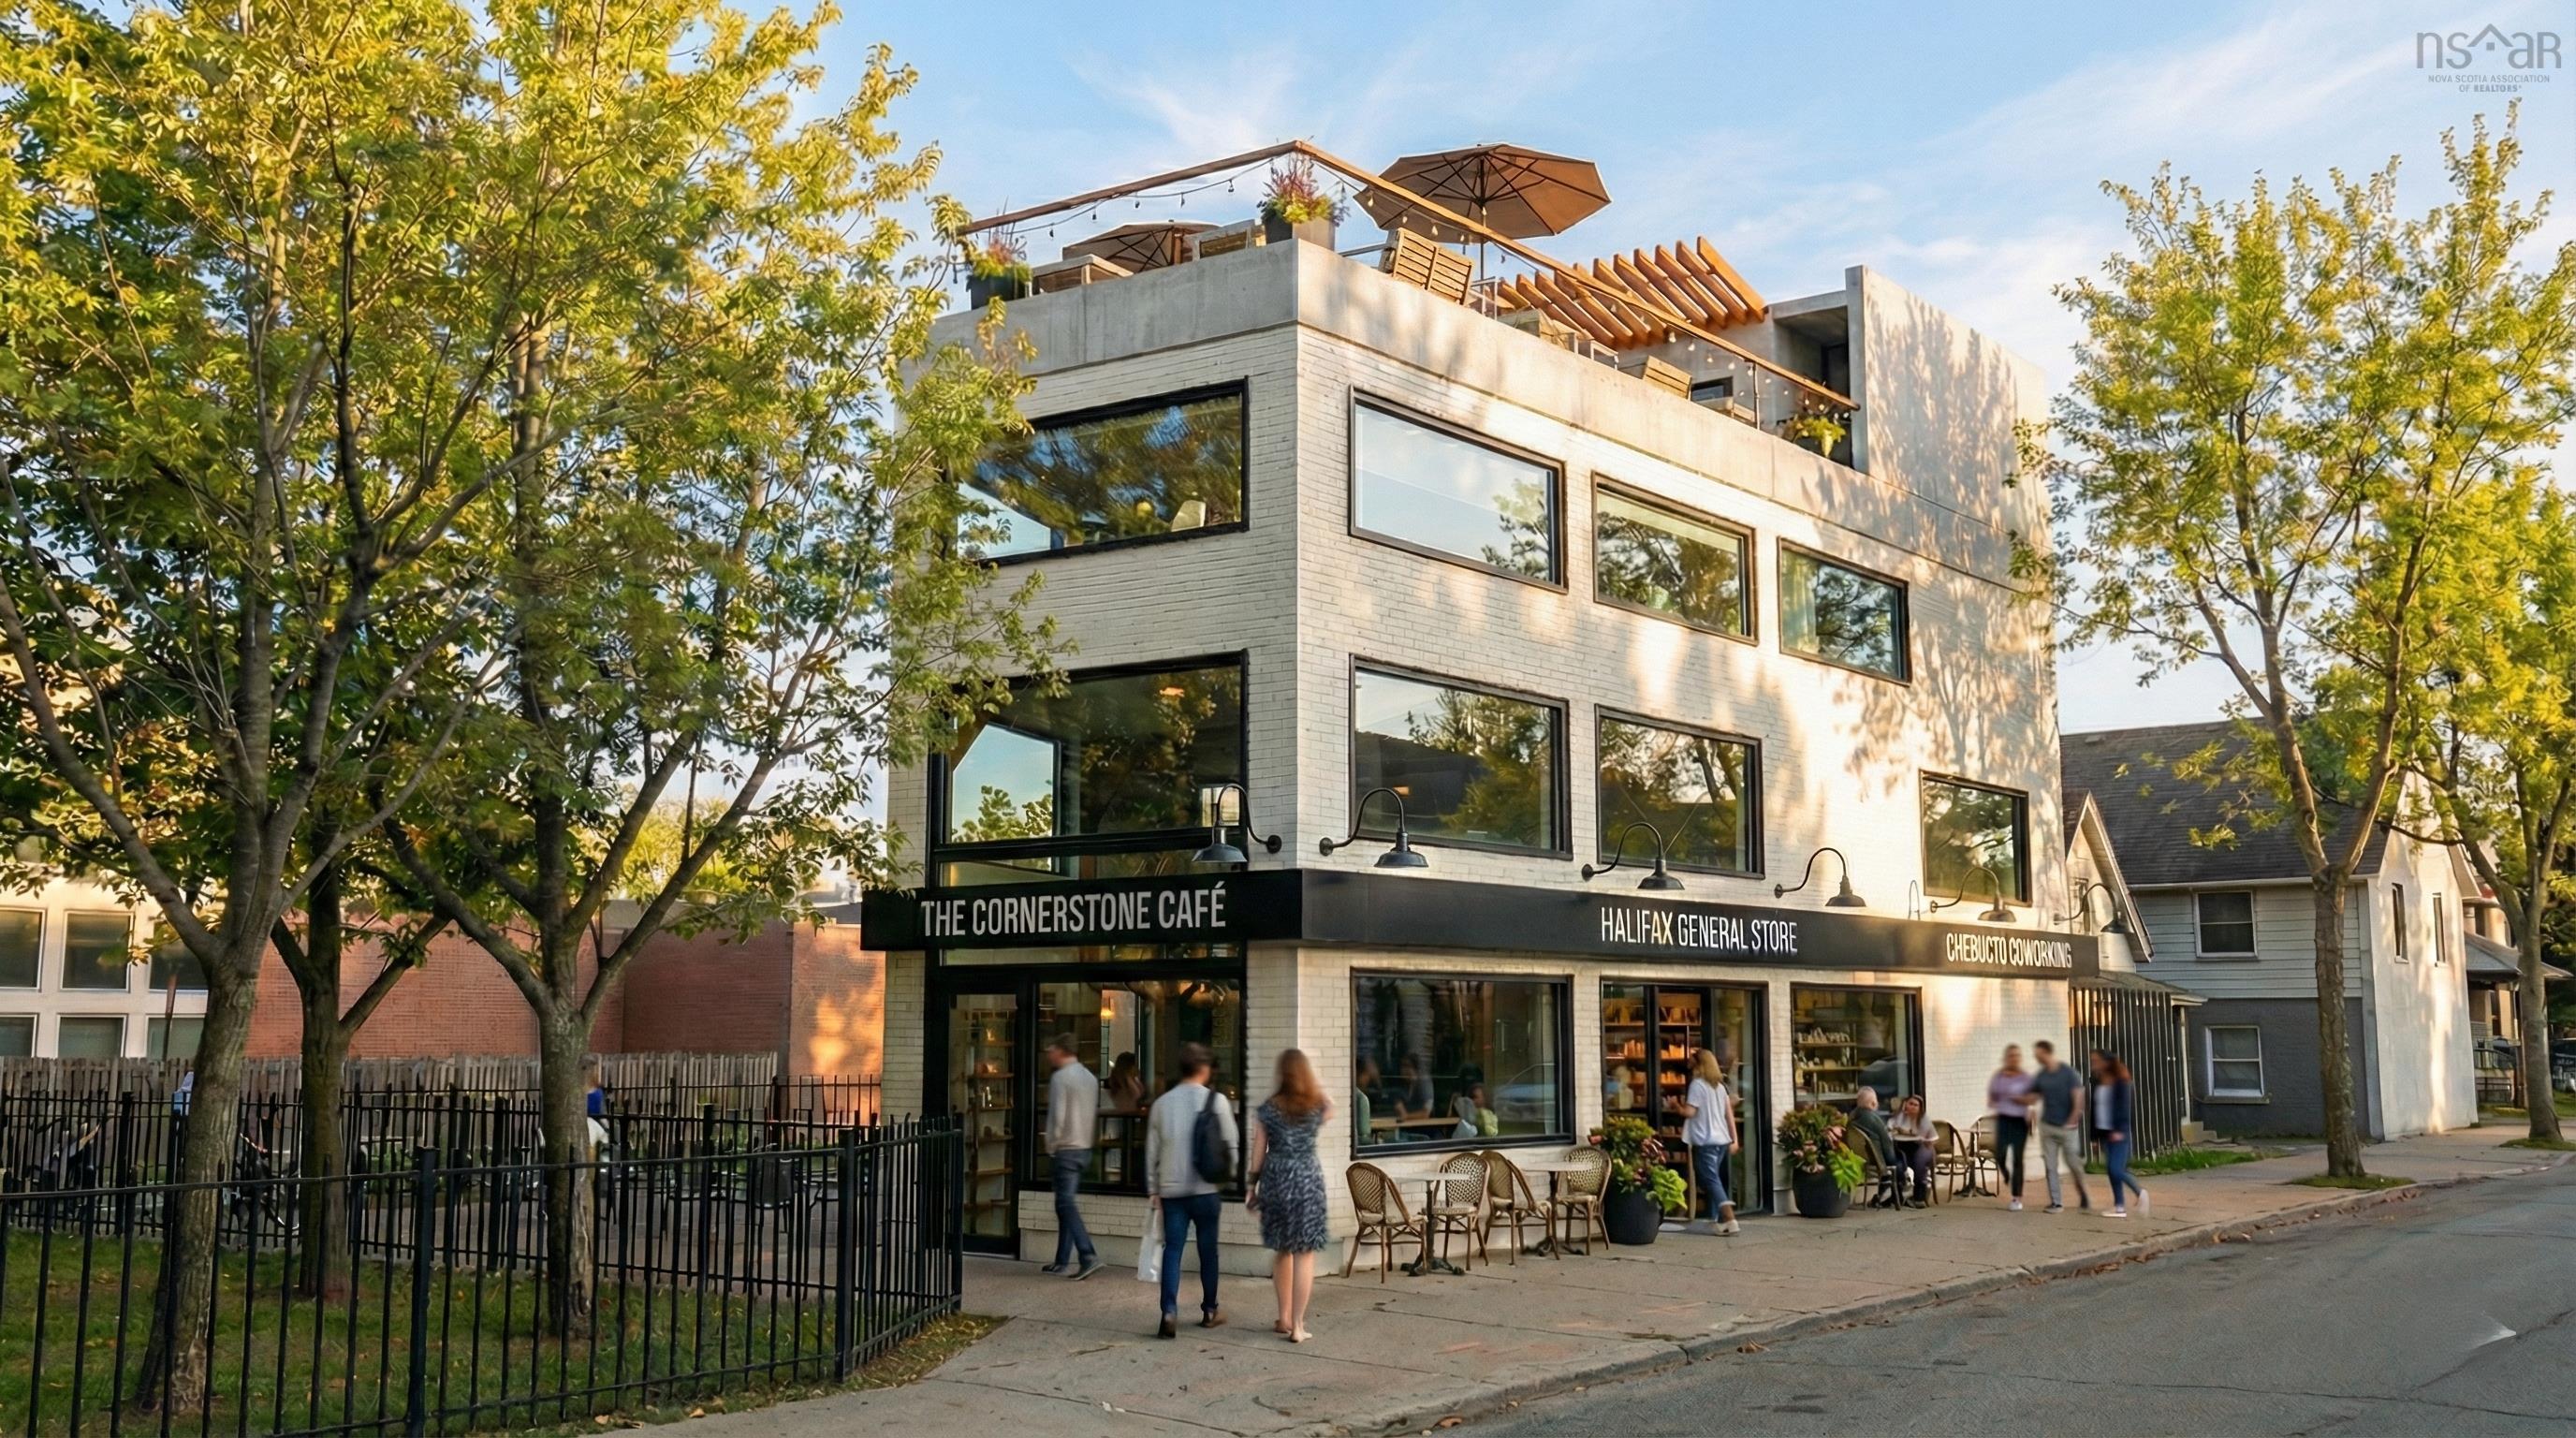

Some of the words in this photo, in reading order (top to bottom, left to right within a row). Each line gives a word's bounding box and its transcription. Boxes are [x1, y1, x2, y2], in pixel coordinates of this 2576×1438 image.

[920, 900, 966, 937] THE
[973, 890, 1150, 935] CORNERSTONE
[1158, 880, 1226, 930] CAFÉ
[1601, 906, 1674, 946] HALIFAX
[1677, 913, 1749, 951] GENERAL
[1750, 918, 1798, 953] STORE
[1946, 932, 2007, 965] CHEBUCTO
[2008, 937, 2072, 969] COWORKING
